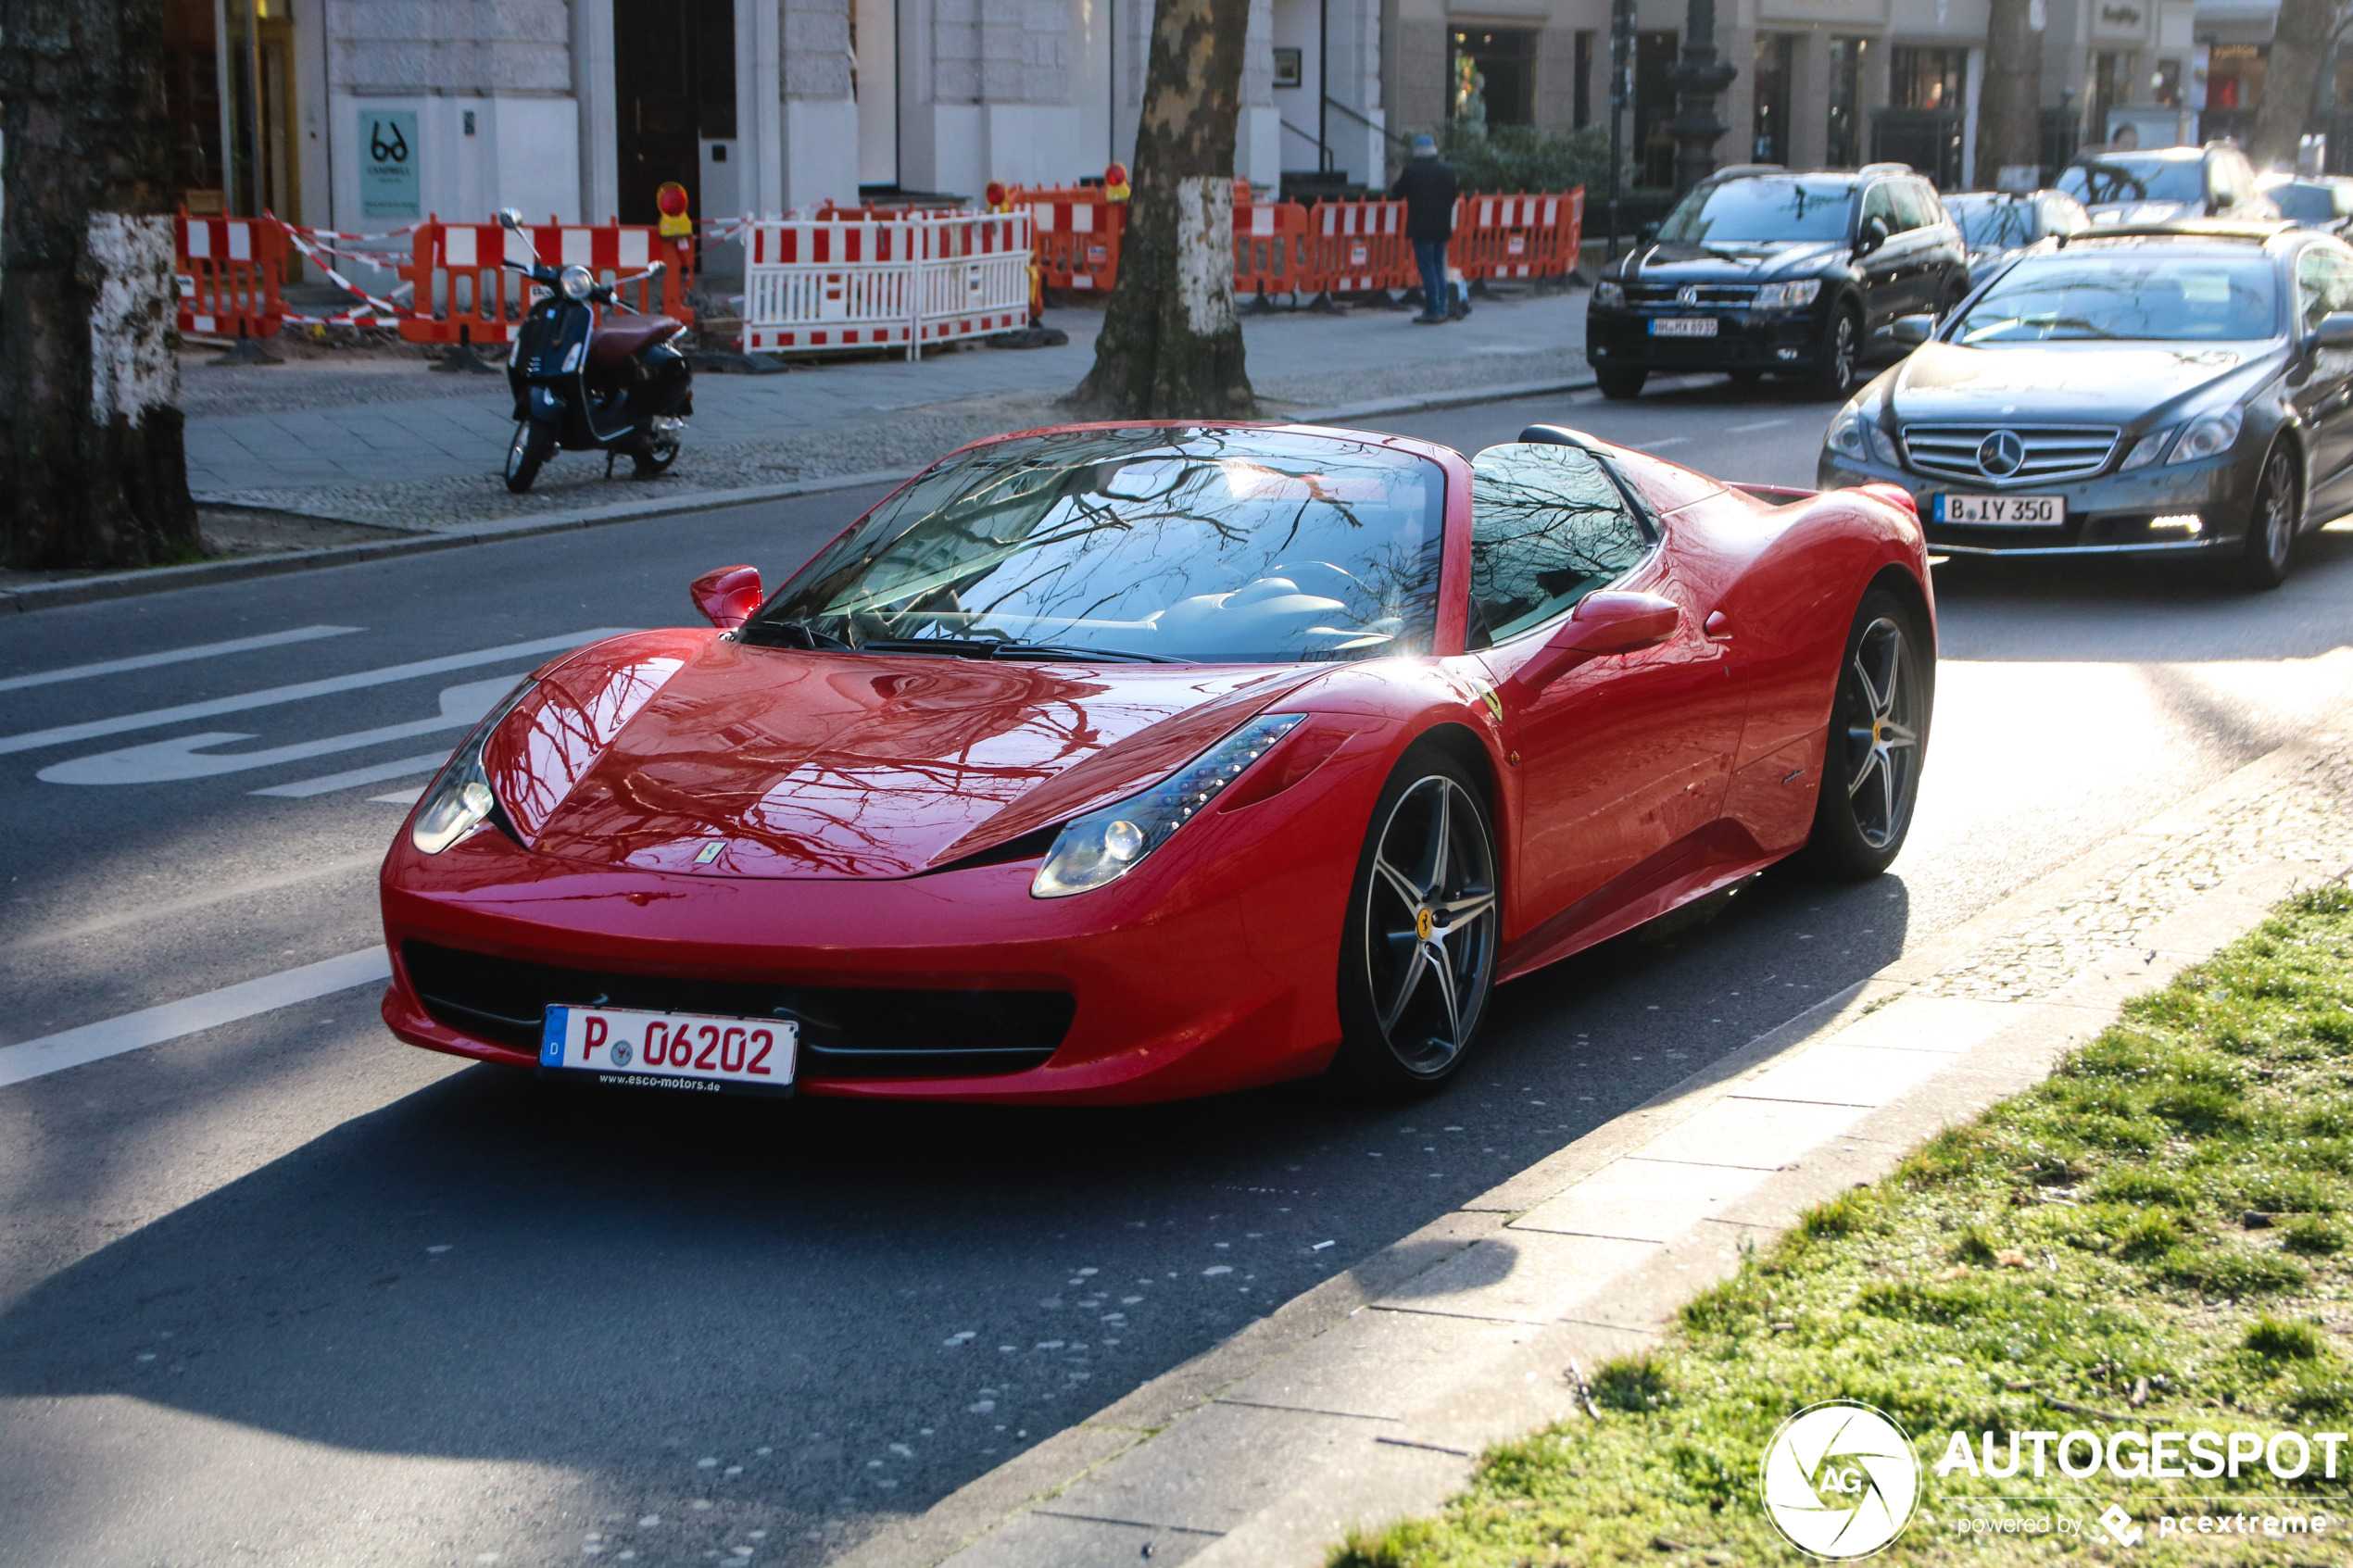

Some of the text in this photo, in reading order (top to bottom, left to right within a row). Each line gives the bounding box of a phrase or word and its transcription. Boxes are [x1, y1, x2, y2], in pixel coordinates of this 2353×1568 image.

[1951, 498, 2052, 521] B IY 350
[549, 1042, 558, 1056] D
[583, 1016, 774, 1074] P 06202
[599, 1073, 721, 1092] www.esco-motors.de
